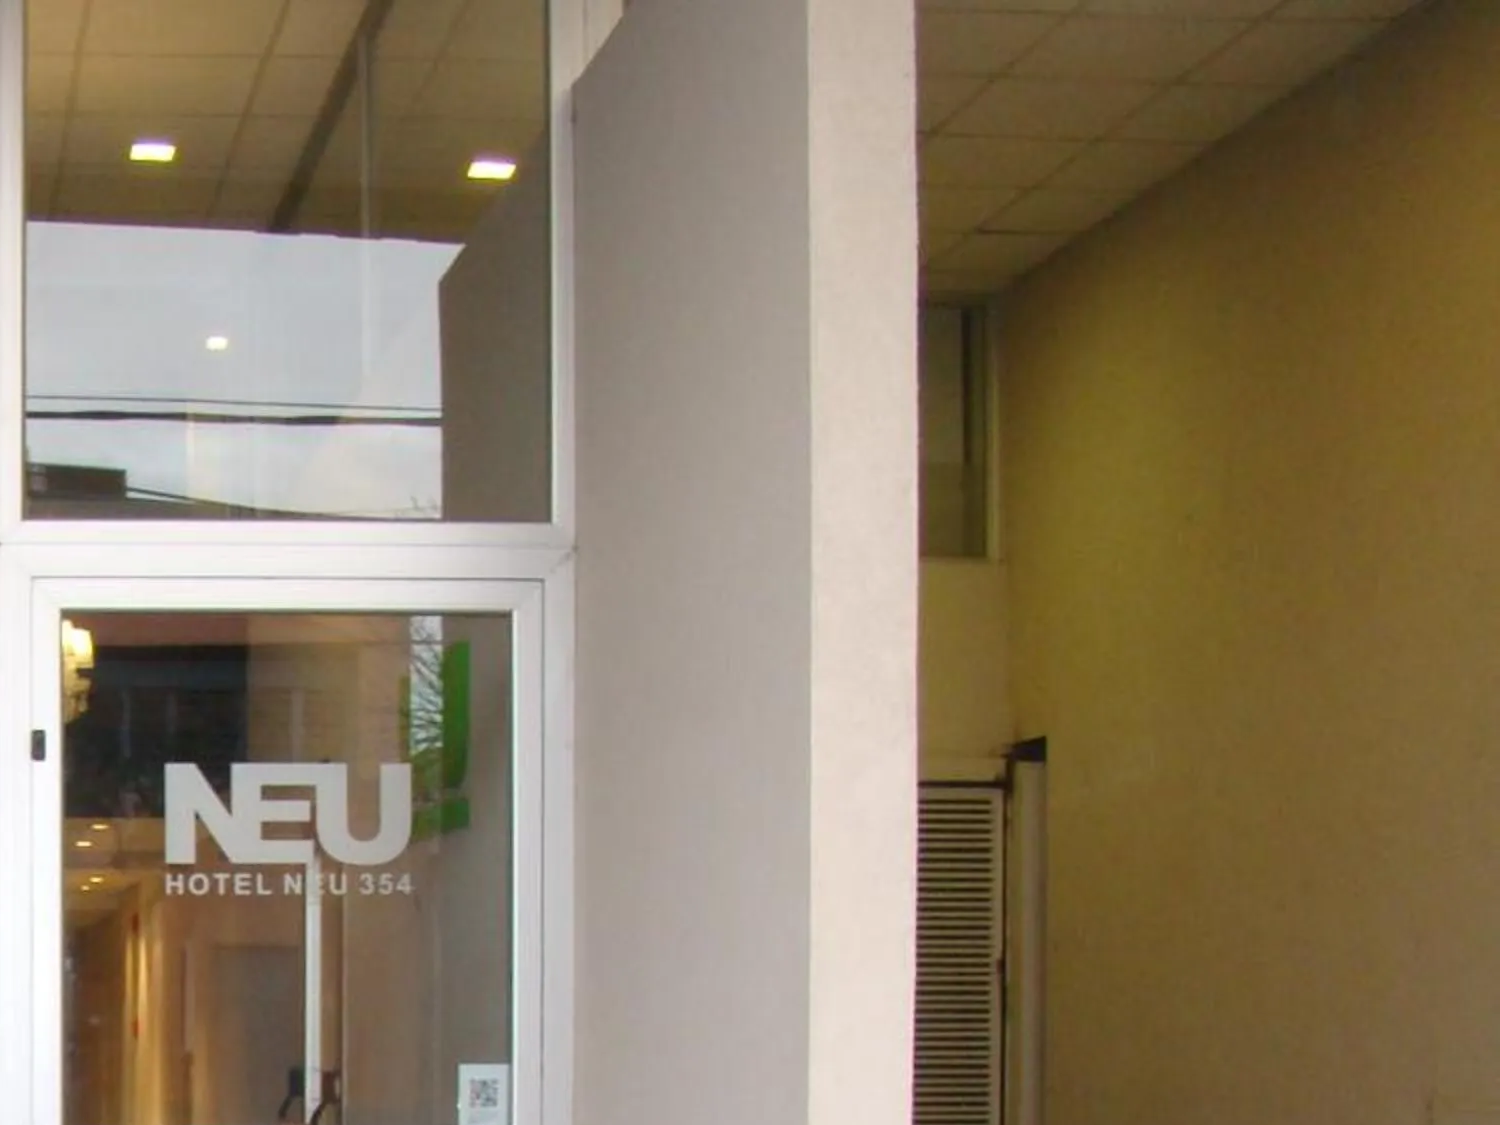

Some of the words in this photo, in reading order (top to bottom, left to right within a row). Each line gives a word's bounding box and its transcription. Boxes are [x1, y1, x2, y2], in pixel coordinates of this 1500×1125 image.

[164, 762, 412, 866] NEU
[165, 873, 272, 895] HOTEL
[284, 873, 347, 895] NEU
[359, 873, 412, 895] 354
